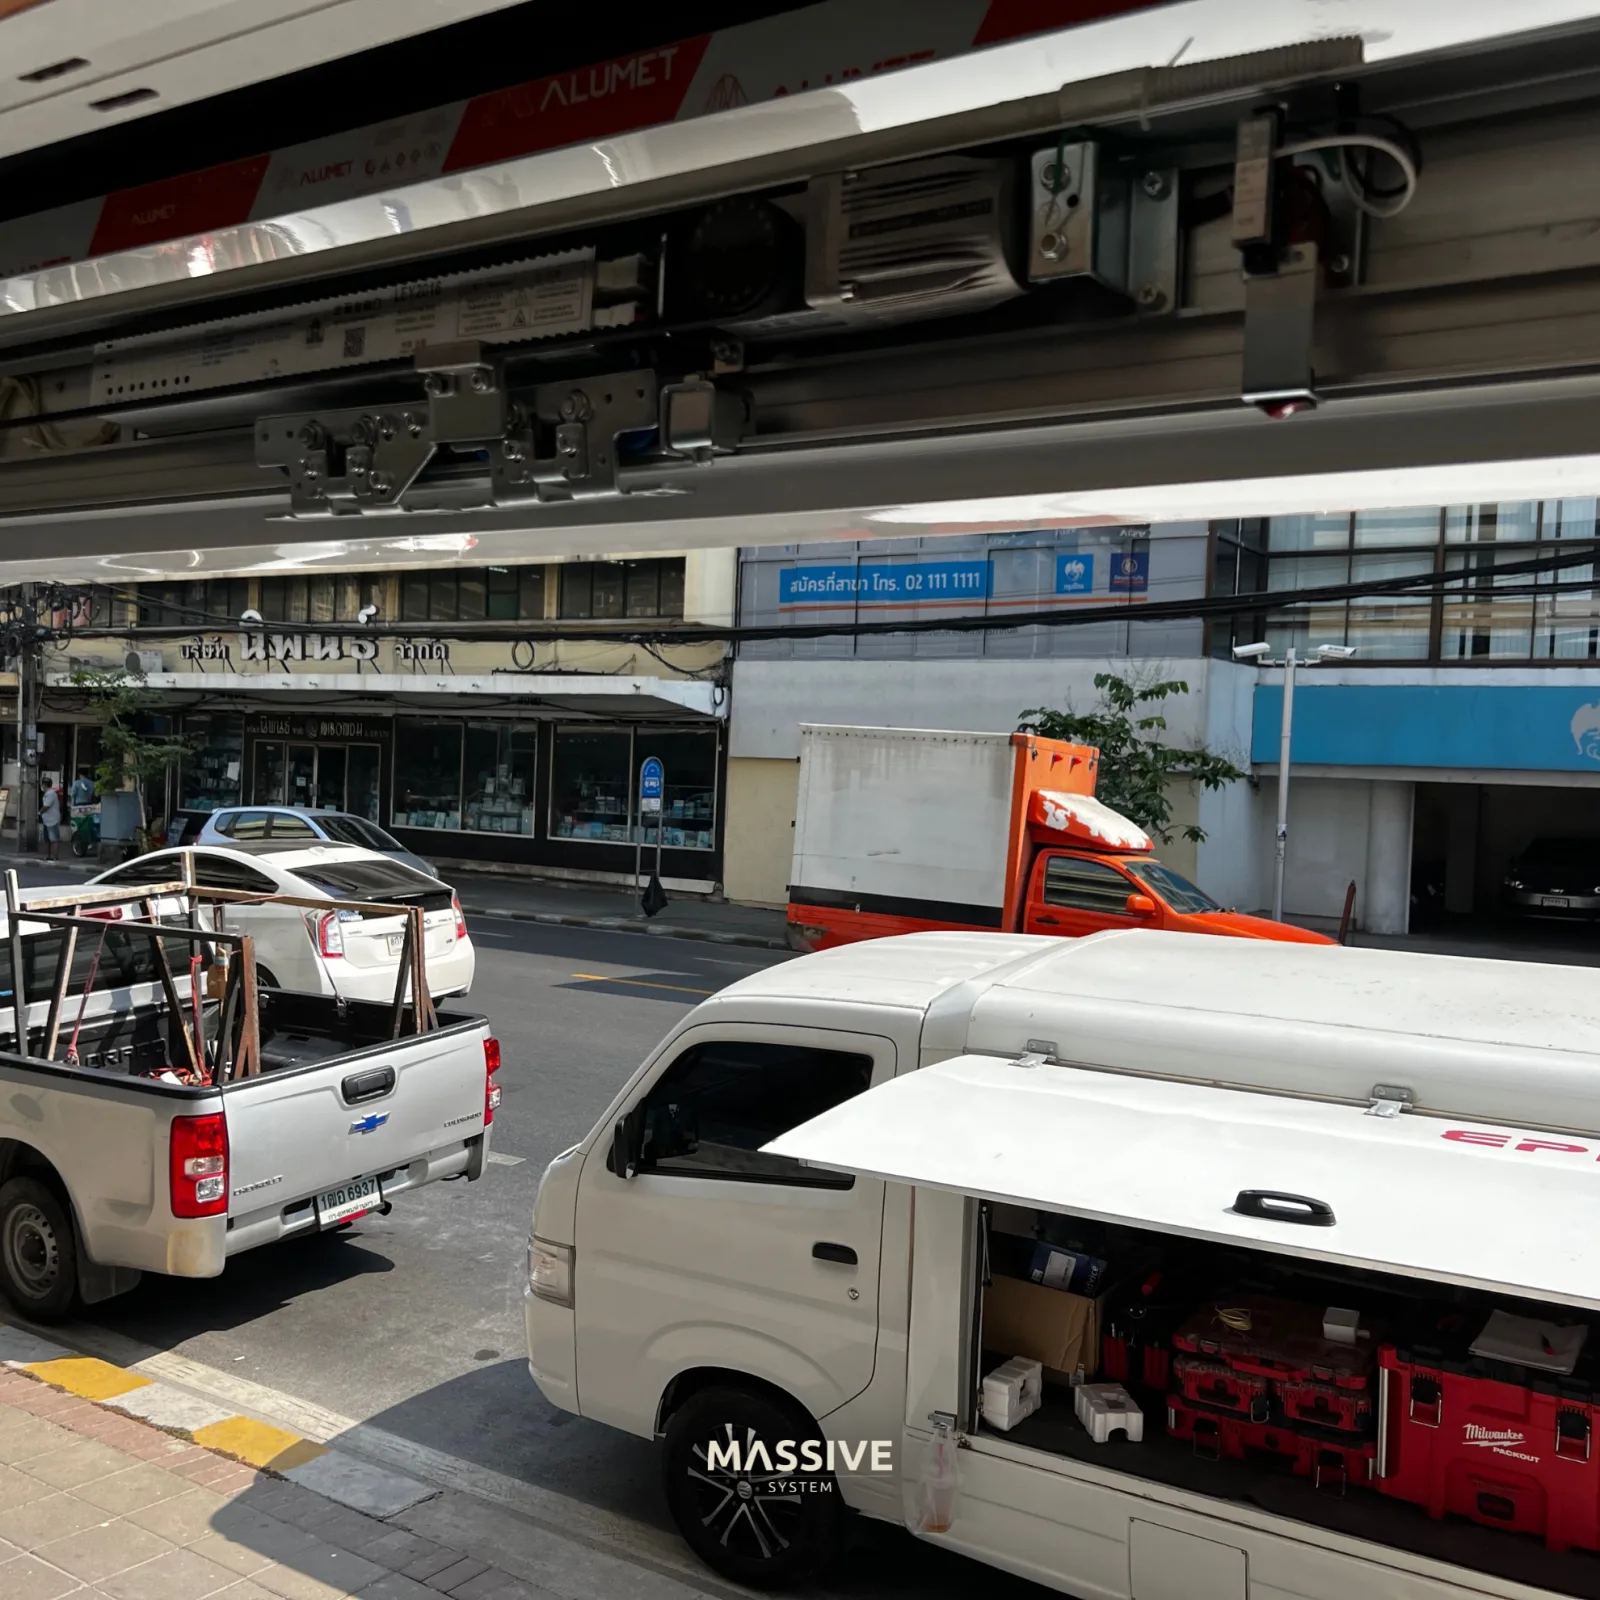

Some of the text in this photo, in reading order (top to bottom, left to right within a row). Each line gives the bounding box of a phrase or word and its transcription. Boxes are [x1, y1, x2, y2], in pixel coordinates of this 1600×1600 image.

[539, 47, 680, 113] ALUMET
[300, 160, 353, 185] ALUMET
[790, 571, 980, 593] สมัครที่สาขา โทร. 02 111 1111
[179, 603, 448, 660] บริษัท นิพนธ์ จำกัด
[1440, 1130, 1600, 1161] EP
[347, 1179, 375, 1201] 6937
[1462, 1423, 1524, 1440] Milwaukee
[1492, 1447, 1541, 1463] PACKOUT
